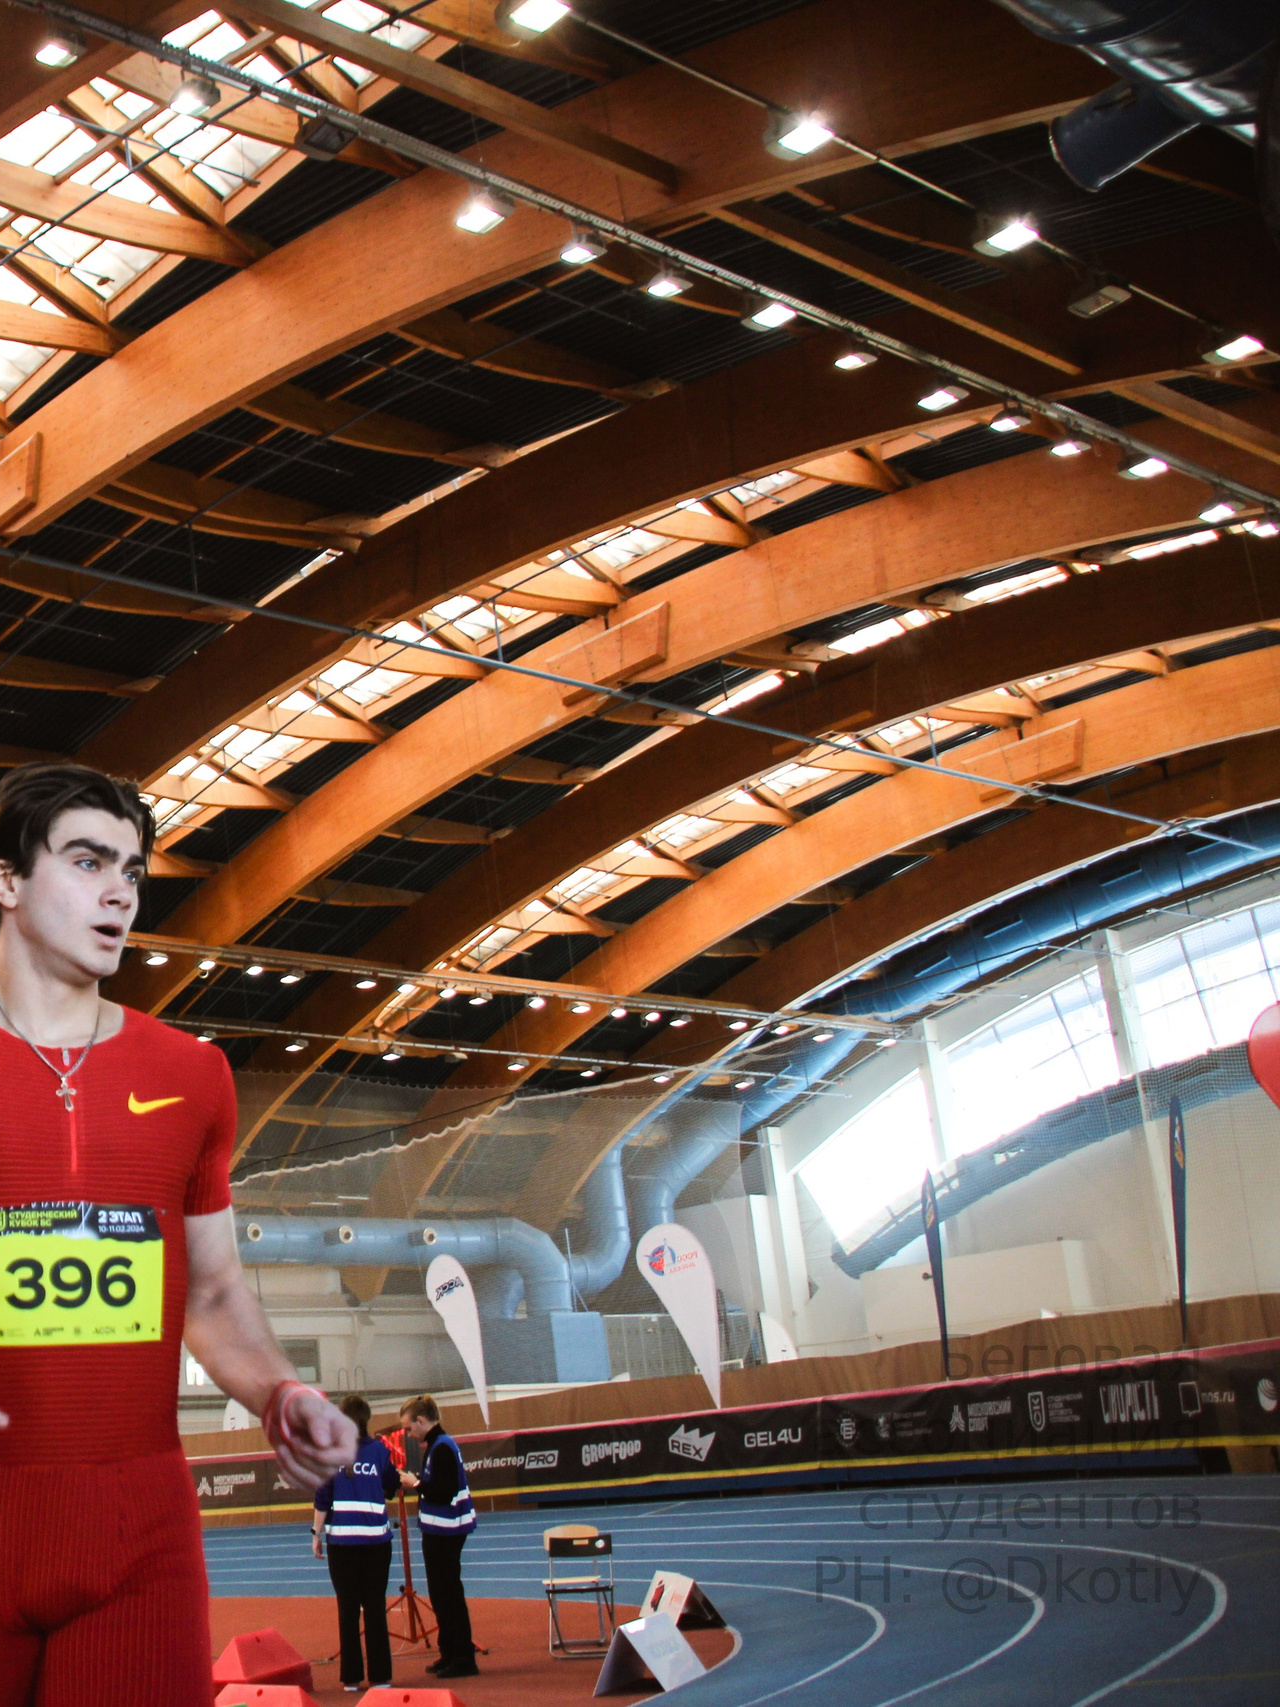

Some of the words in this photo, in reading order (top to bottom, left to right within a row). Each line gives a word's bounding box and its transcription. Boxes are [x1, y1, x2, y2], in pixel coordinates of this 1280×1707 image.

[8, 1208, 79, 1219] СТУДЕНЧЕСКИЙ
[98, 1210, 108, 1223] 2
[109, 1210, 143, 1223] ЭТАП
[8, 1219, 39, 1228] КУБОК
[5, 1256, 136, 1310] 396
[1201, 1391, 1235, 1403] mos.ru
[967, 1397, 1012, 1418] МОСКОВСКИЙ
[968, 1417, 989, 1432] СПОРТ
[744, 1427, 802, 1448] GEL4U
[581, 1440, 642, 1467] GROWFOOD
[671, 1439, 703, 1459] REX
[526, 1452, 556, 1467] PRO
